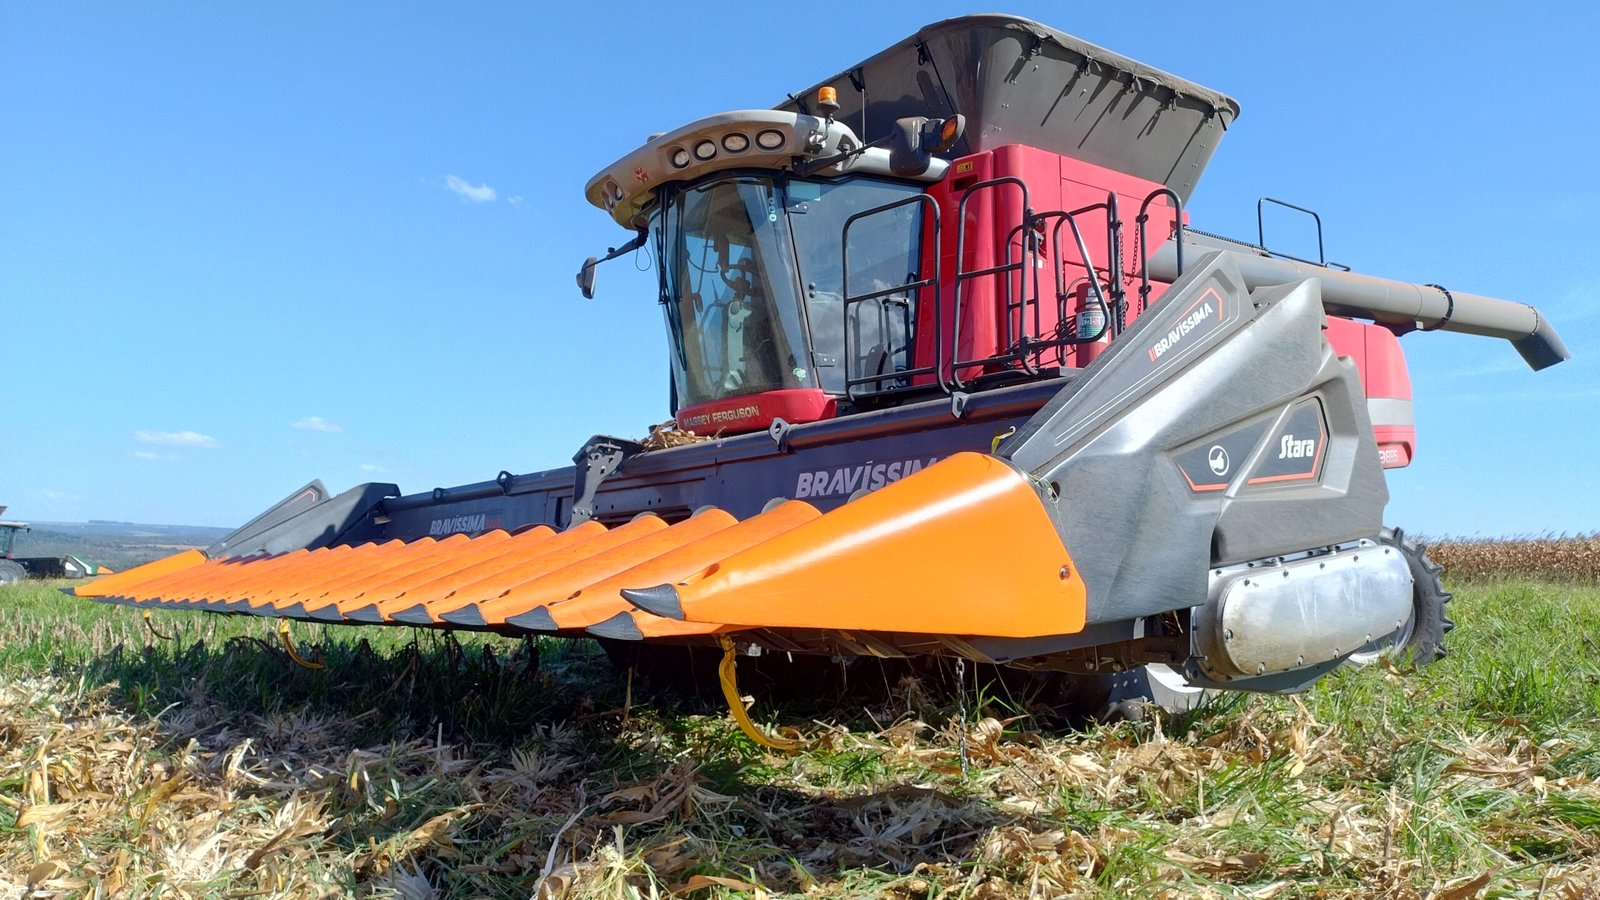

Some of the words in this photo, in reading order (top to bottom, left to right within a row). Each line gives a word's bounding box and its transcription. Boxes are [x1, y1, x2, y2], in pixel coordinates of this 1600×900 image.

[683, 413, 710, 427] MASSEY
[712, 405, 760, 423] FERGUSON
[1278, 434, 1315, 459] Stara
